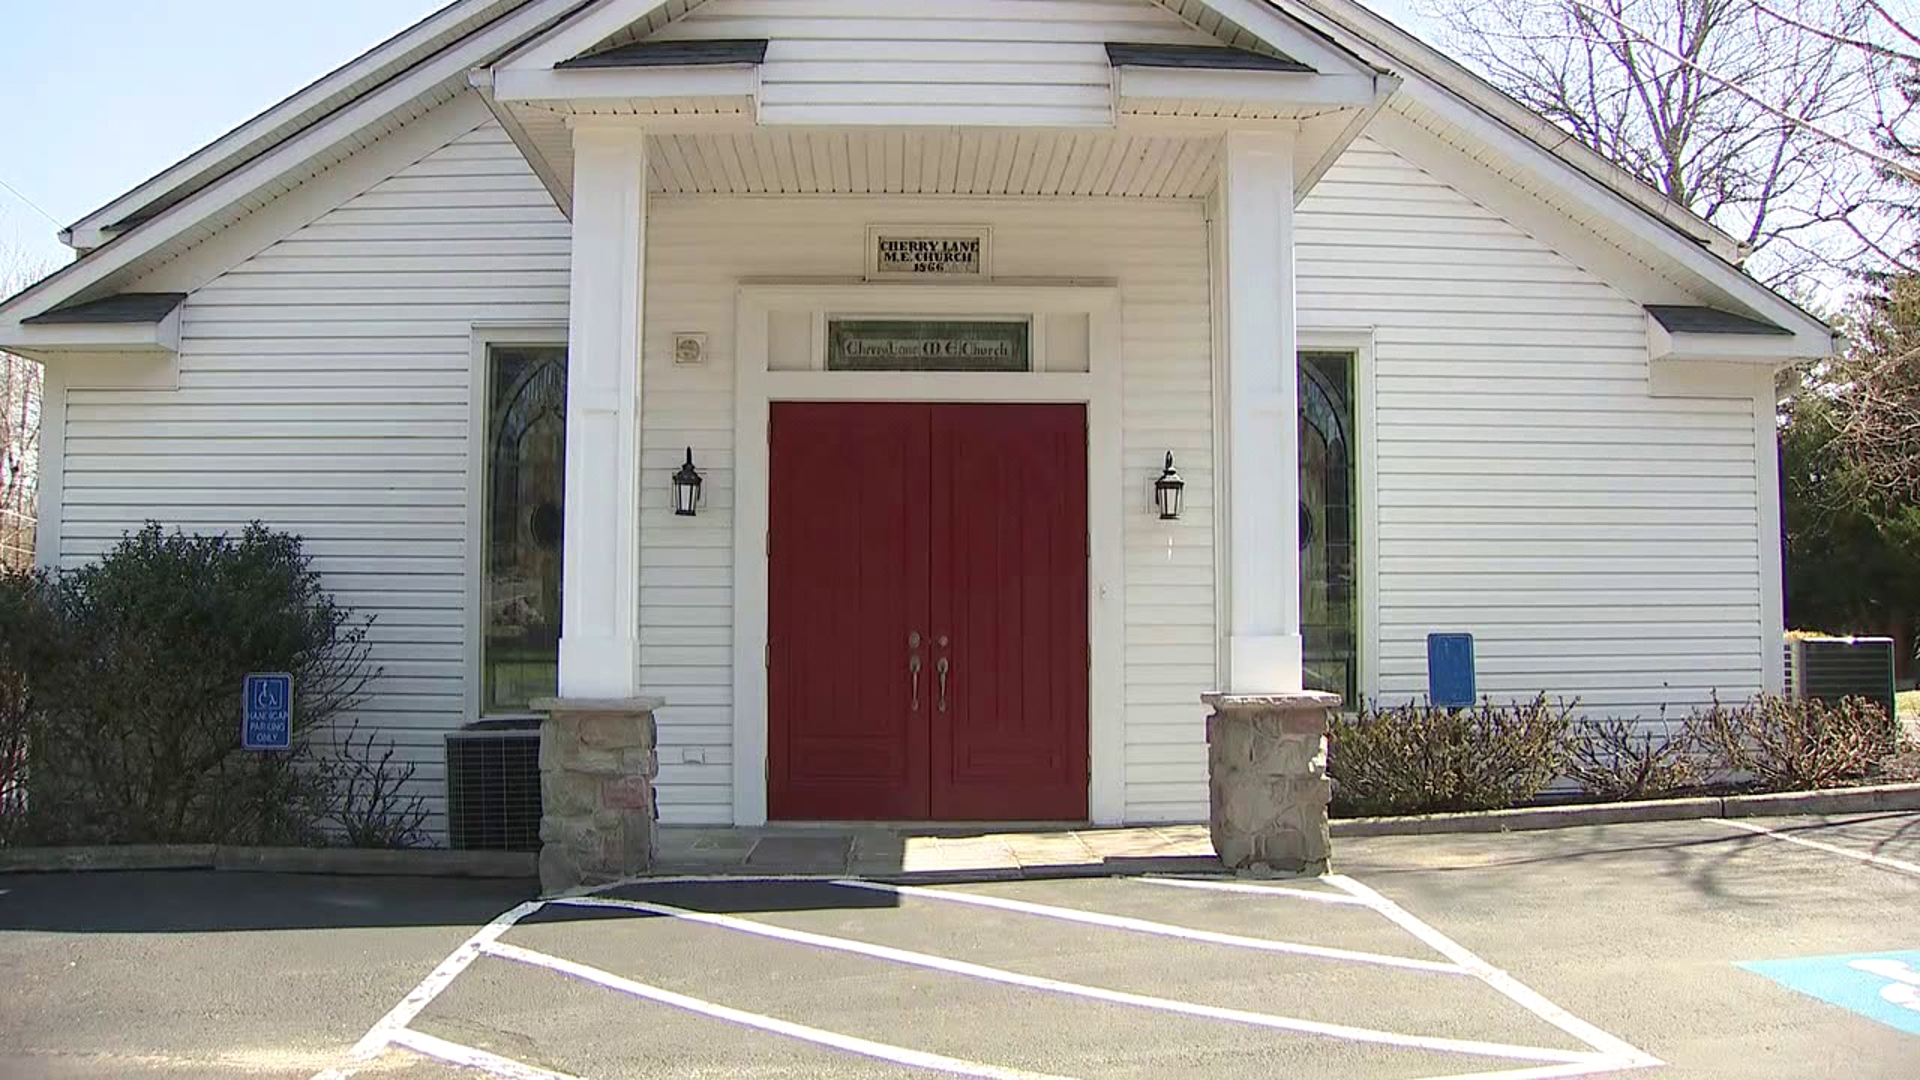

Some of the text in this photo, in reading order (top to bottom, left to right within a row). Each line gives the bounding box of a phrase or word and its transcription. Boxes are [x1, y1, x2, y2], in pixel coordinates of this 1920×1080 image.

[880, 241, 979, 252] CHERRY LANE
[914, 252, 972, 262] CHURCH
[962, 341, 1008, 357] Church
[249, 722, 286, 732] PARKING
[256, 733, 278, 742] ONLY
